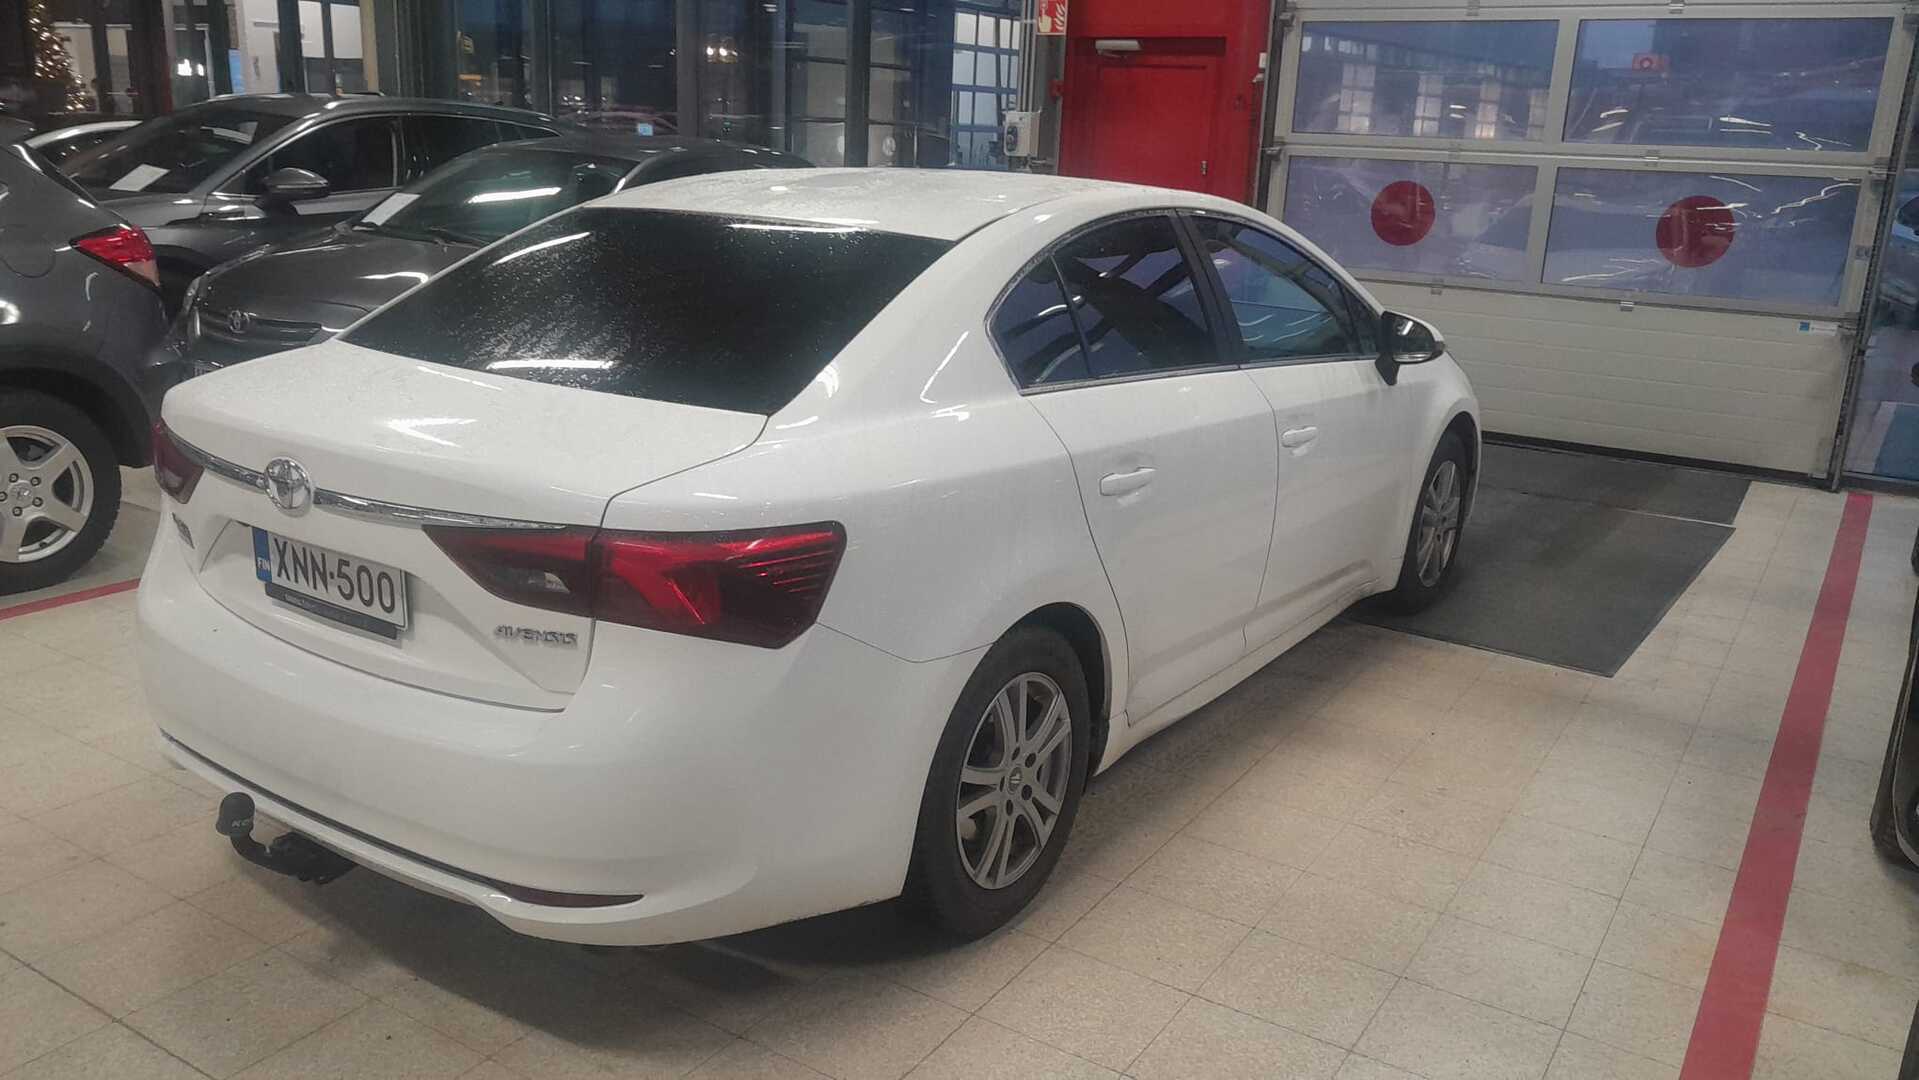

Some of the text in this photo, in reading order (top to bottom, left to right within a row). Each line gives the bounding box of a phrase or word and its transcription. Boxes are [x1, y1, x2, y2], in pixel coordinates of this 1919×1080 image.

[257, 556, 271, 571] FIN
[274, 538, 396, 614] XNN-500
[495, 625, 578, 645] AVENSIS
